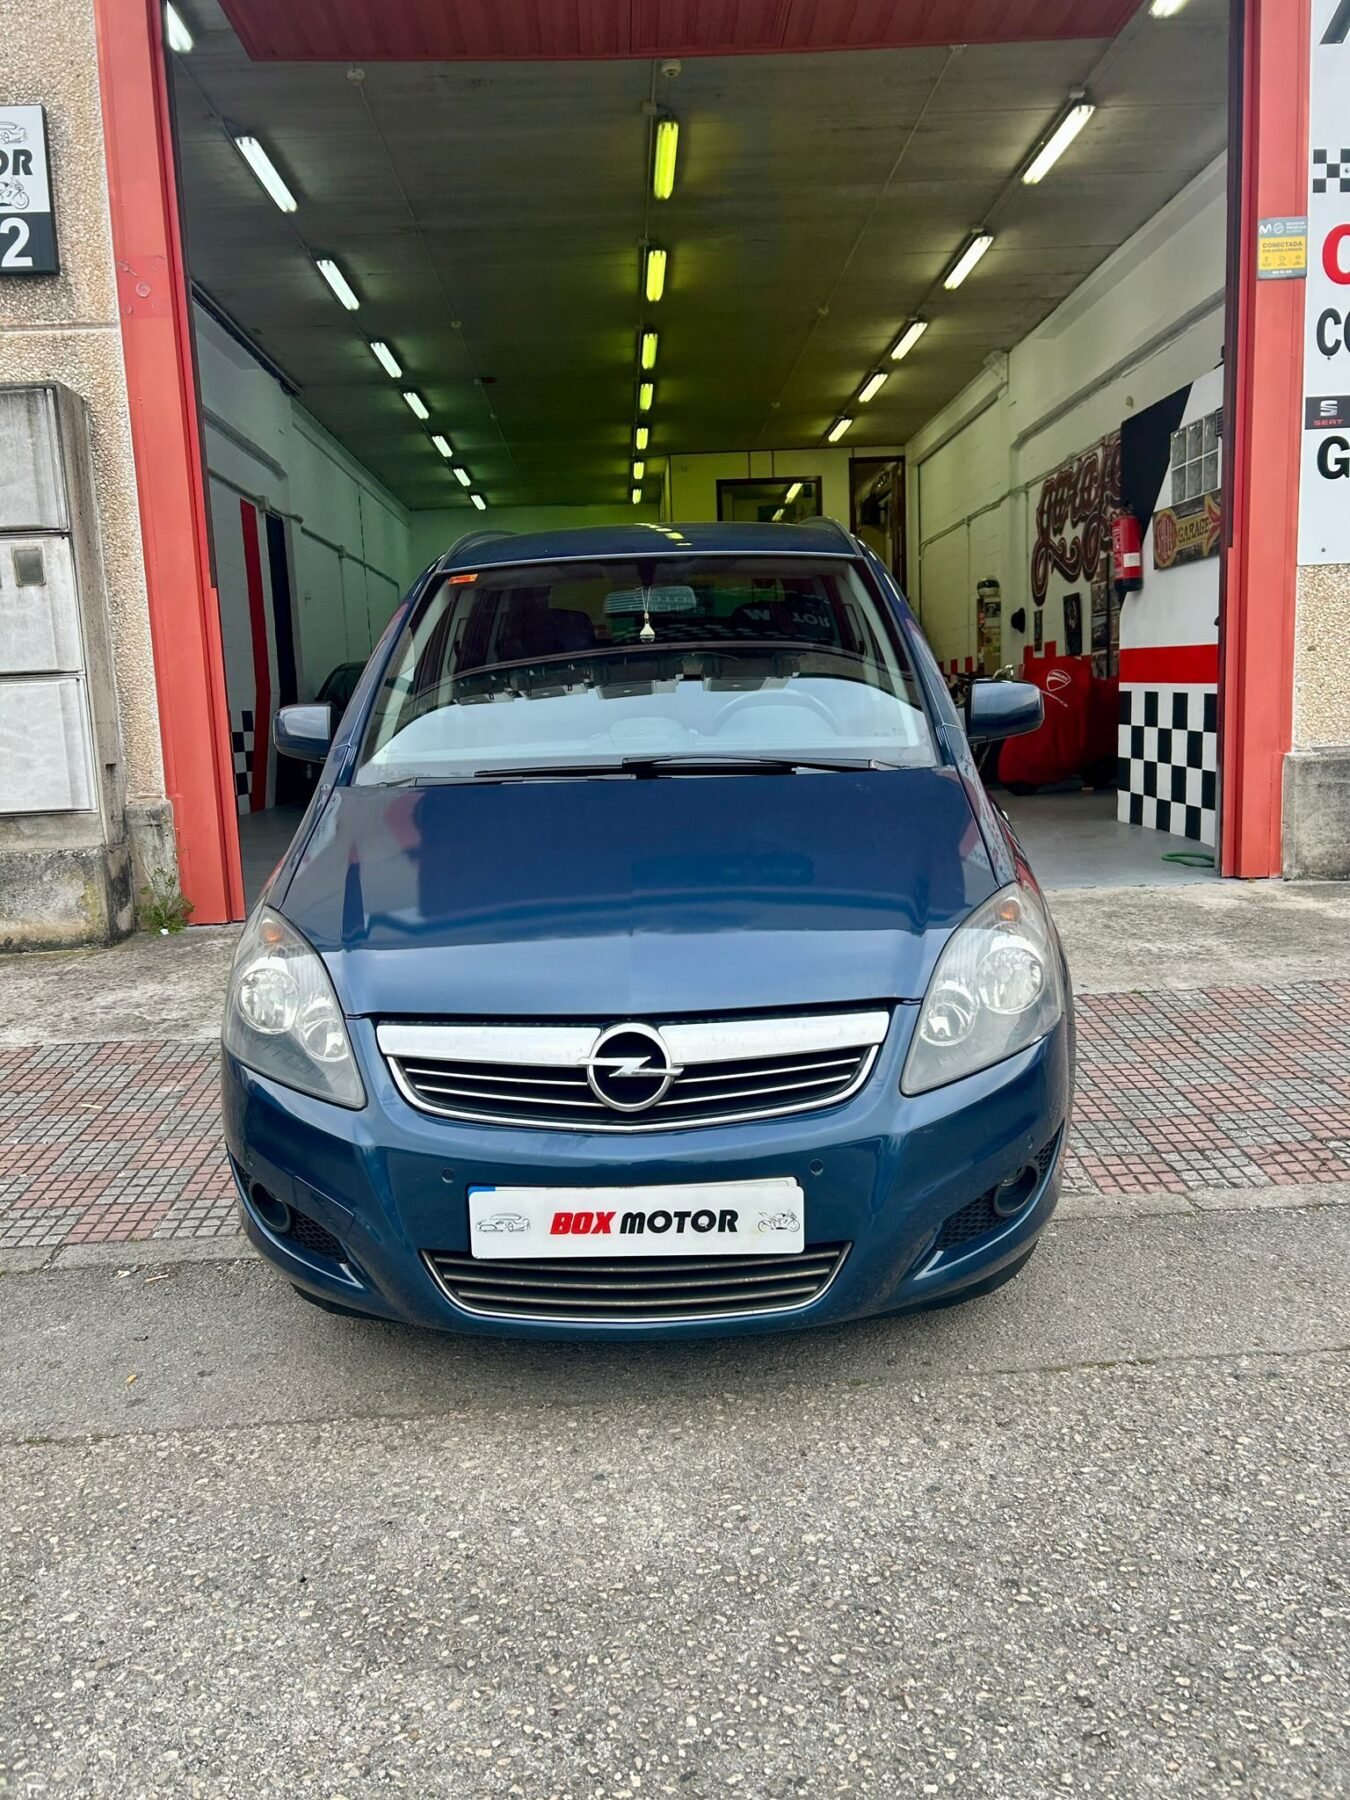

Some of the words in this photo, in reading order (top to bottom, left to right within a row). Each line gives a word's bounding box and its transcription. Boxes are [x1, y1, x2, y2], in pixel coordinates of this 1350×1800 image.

[1262, 240, 1303, 248] CONECTADA
[1316, 307, 1350, 357] C
[1313, 418, 1345, 426] SEAT
[1178, 516, 1209, 543] GARAGE
[549, 1211, 616, 1235] BOX
[619, 1209, 739, 1235] MOTOR
